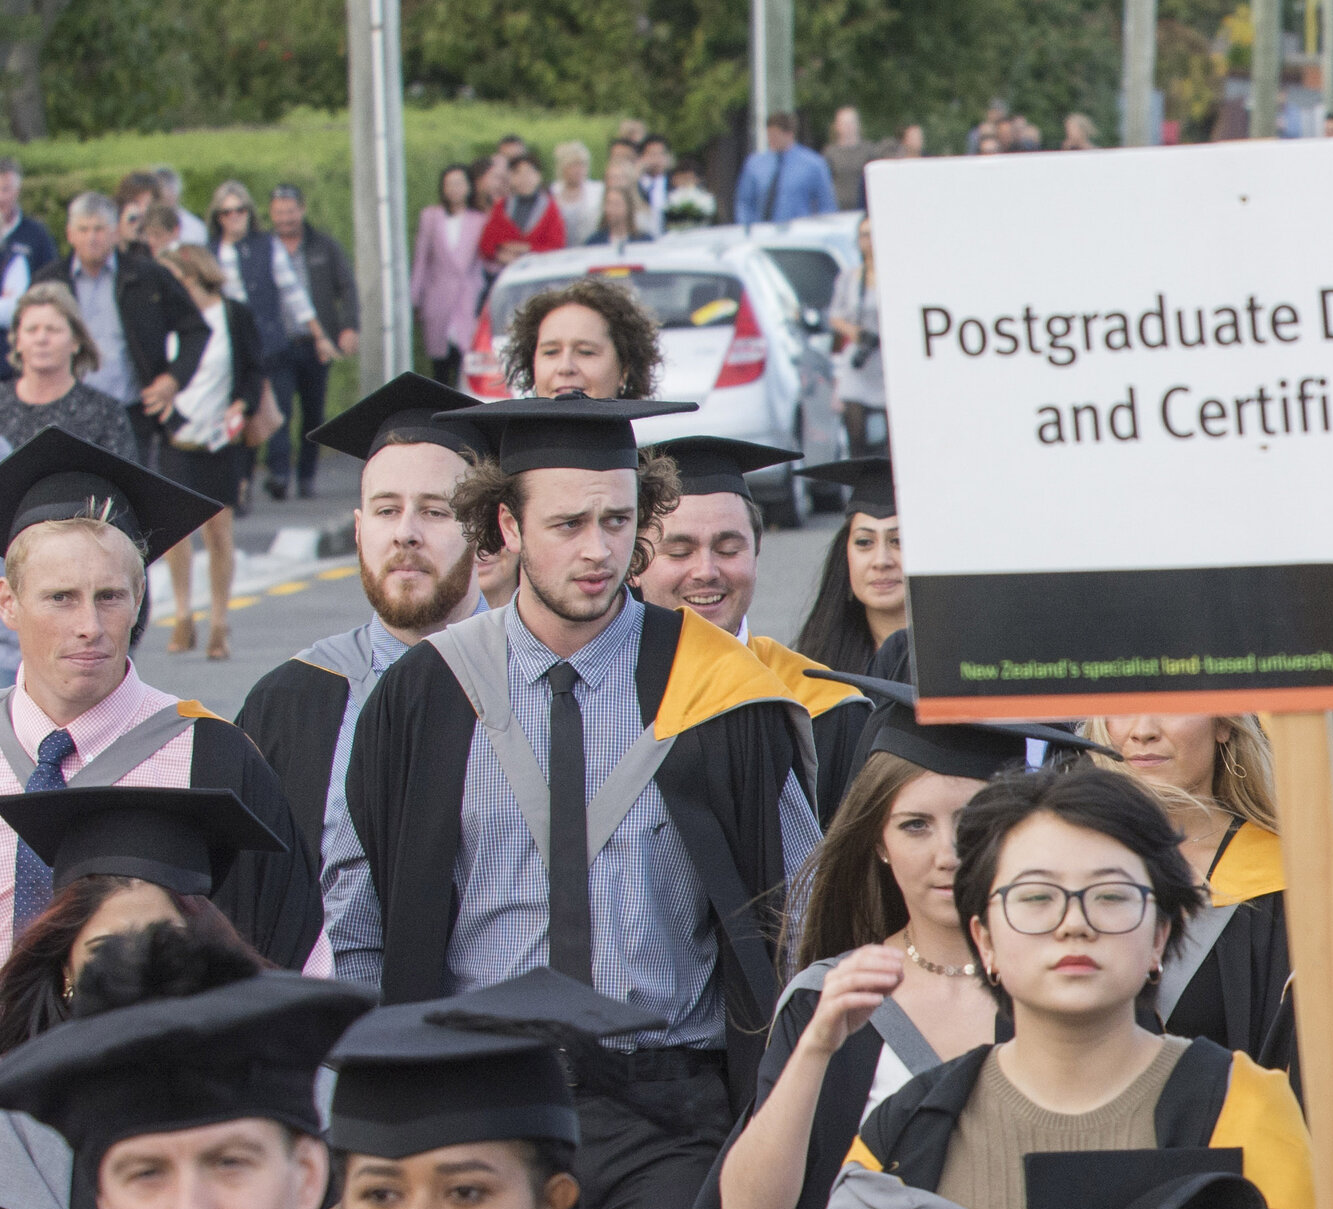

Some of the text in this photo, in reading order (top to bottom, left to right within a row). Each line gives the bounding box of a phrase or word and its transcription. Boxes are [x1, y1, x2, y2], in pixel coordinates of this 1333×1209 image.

[921, 293, 1301, 367] Postgraduate
[1037, 387, 1141, 446] and
[959, 661, 999, 680] New
